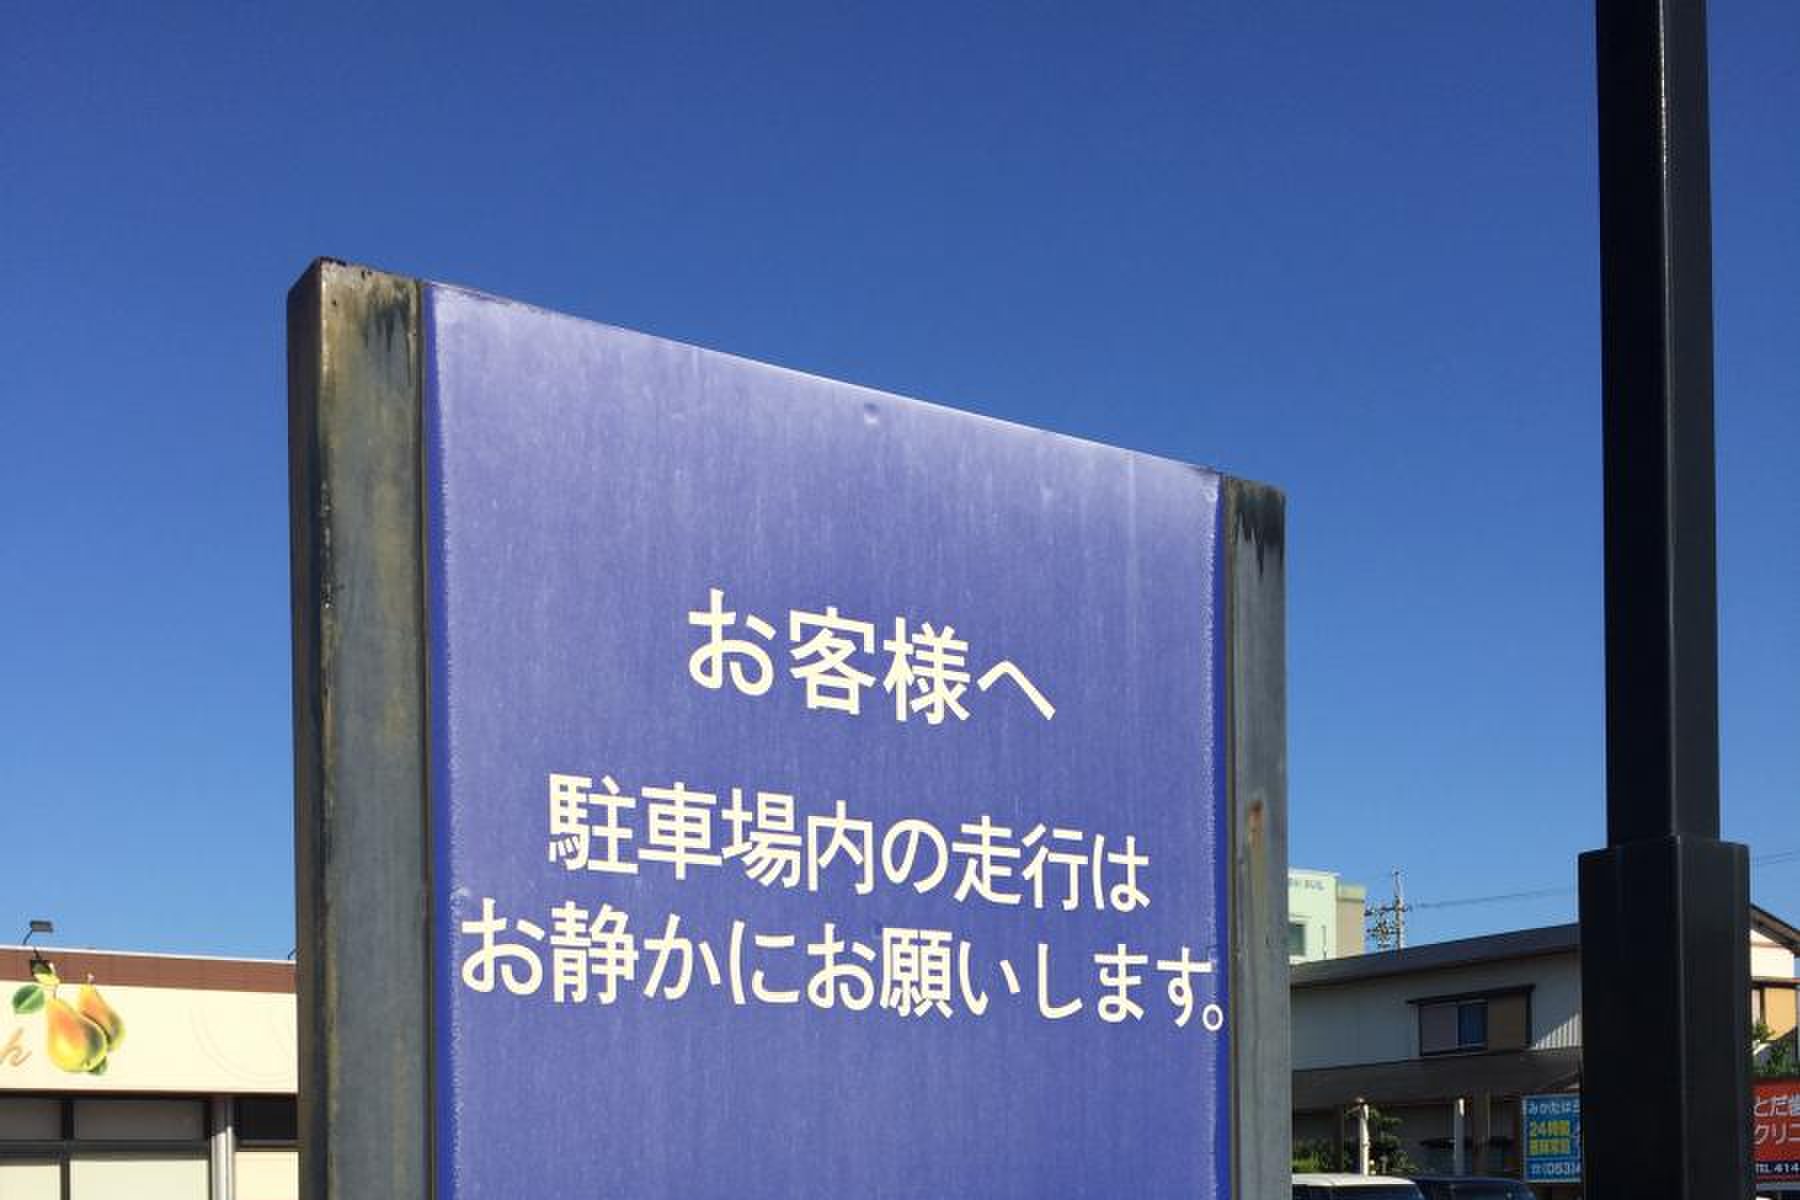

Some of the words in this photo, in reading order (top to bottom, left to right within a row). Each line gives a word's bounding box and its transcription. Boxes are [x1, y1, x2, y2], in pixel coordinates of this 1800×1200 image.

[687, 588, 1057, 725] お客様へ
[548, 773, 1151, 913] 駐車場内の走行は
[460, 897, 1226, 1032] お静かにお願いします。
